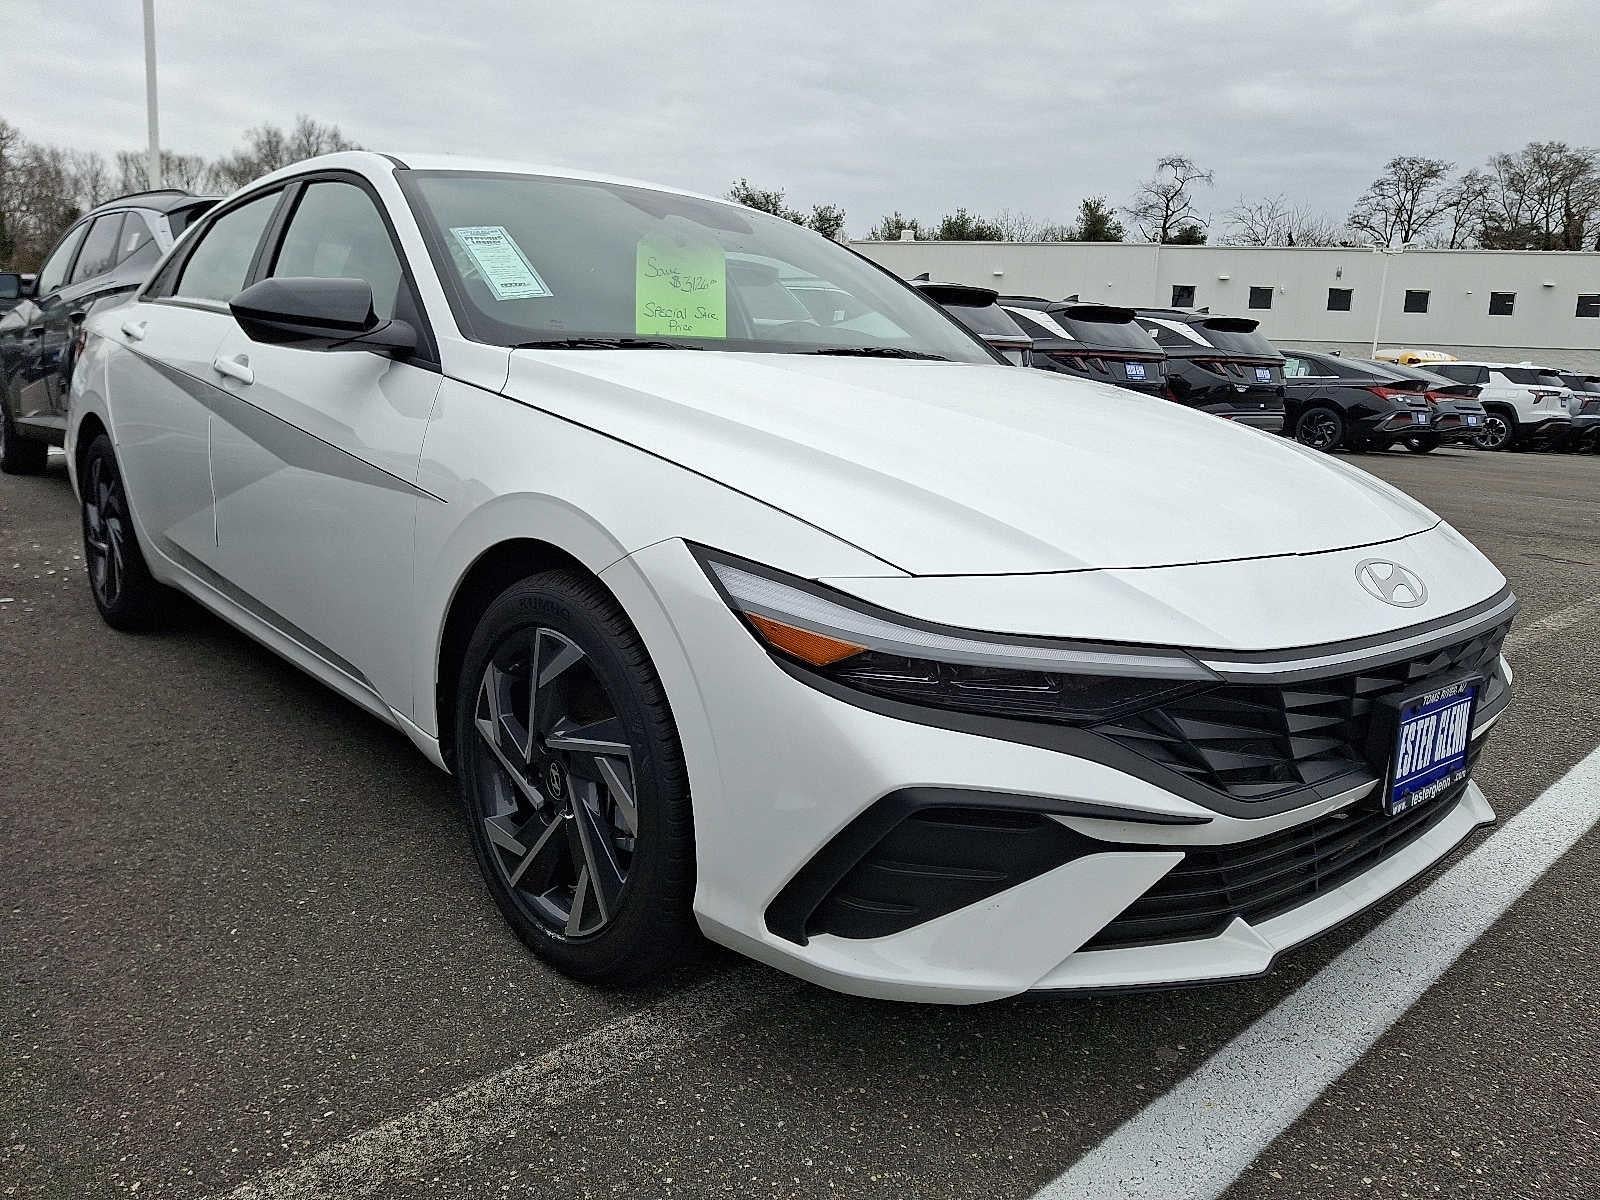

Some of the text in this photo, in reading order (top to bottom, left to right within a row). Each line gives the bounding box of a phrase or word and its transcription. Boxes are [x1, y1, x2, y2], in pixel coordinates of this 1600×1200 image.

[1395, 701, 1471, 780] ESTER GLENN
[1411, 777, 1451, 806] lesterglenn
